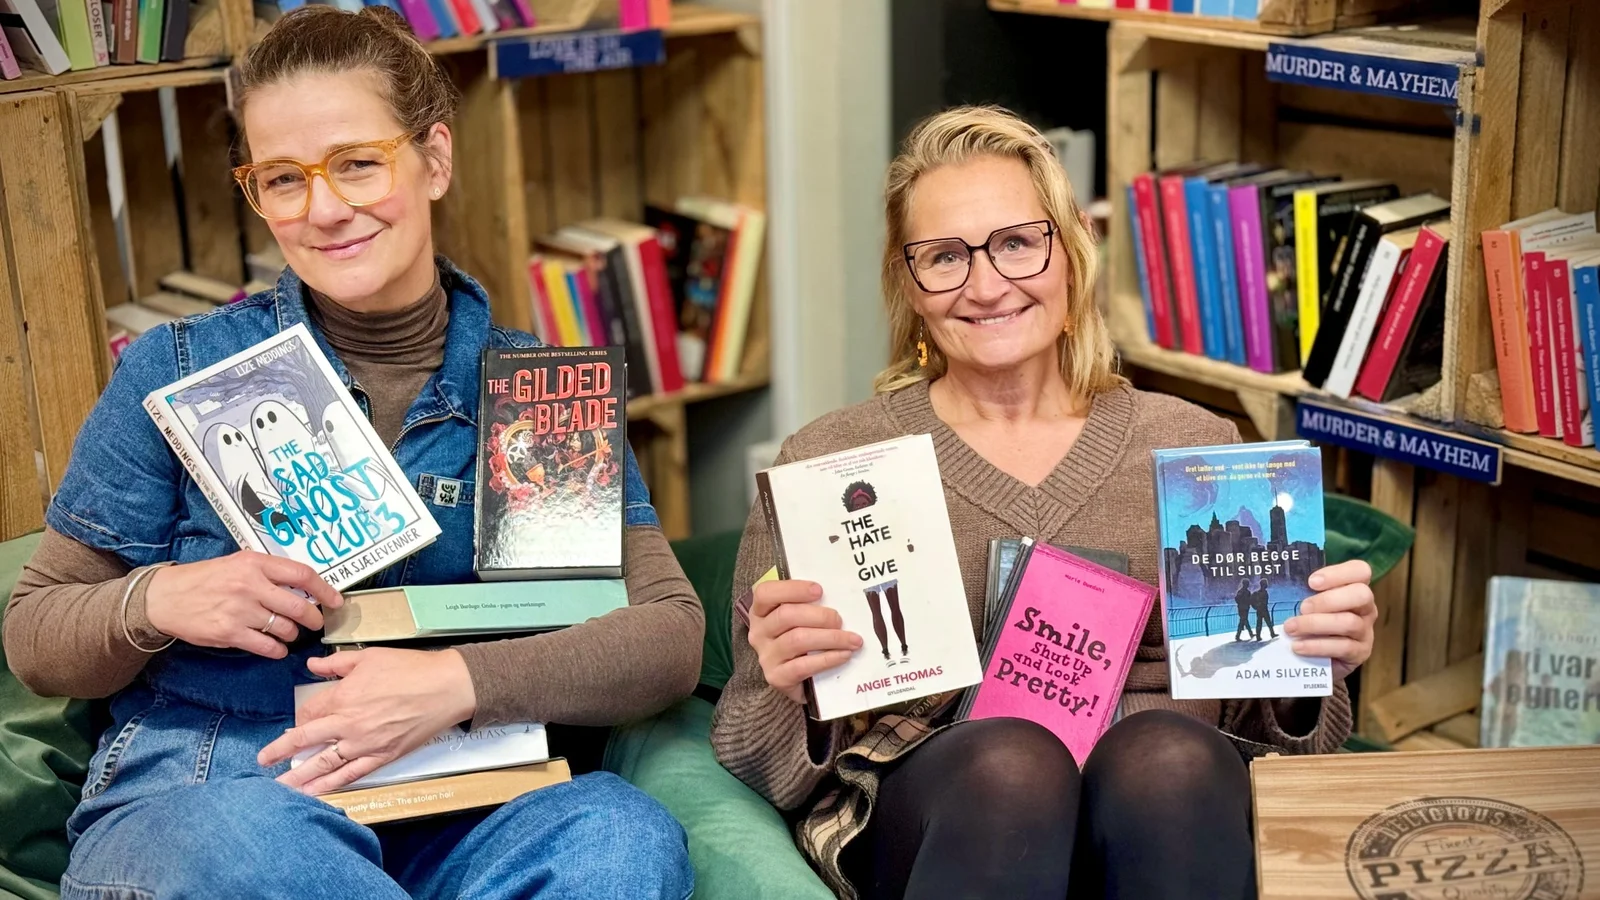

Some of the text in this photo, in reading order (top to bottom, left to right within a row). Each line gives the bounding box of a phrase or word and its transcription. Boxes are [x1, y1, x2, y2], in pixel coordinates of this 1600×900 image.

[91, 0, 102, 37] LOSER
[1266, 52, 1459, 100] MURDER & MAYHEM
[234, 340, 297, 377] LIZE MEDDINGS
[487, 362, 611, 403] THE GILDED
[534, 397, 617, 436] BLADE
[268, 439, 303, 463] THE
[1302, 409, 1491, 473] MURDER & MAYHEM
[145, 398, 166, 422] LIZE
[162, 424, 200, 472] MEDDINGS
[207, 490, 226, 512] SAD
[220, 510, 249, 545] GHOST
[273, 451, 329, 497] SAD
[261, 456, 381, 546] GHOST
[763, 490, 772, 514] Angie
[306, 502, 406, 565] CLUB 3
[841, 514, 874, 534] THE
[849, 526, 892, 550] HATE
[339, 562, 353, 583] PÅ
[351, 527, 421, 574] SJÆLEVENNER
[853, 551, 865, 565] U
[1191, 550, 1300, 564] DE DØR BEGGE
[858, 559, 898, 582] GIVE
[1210, 564, 1281, 577] TIL SIDST
[1014, 607, 1112, 671] Smile,
[1013, 652, 1081, 686] and Look
[1030, 642, 1071, 667] Shut
[1549, 653, 1598, 680] var
[855, 665, 943, 694] ANGIE THOMAS
[1235, 667, 1327, 680] ADAM SILVERA
[887, 686, 915, 696] GYLDENDAL
[470, 728, 507, 740] GLASS
[346, 804, 368, 814] Holly
[369, 800, 395, 810] Black:
[396, 798, 412, 806] The
[413, 793, 438, 803] stolen
[1379, 805, 1506, 839] DELICIOUS
[1422, 836, 1485, 854] Finest
[1363, 840, 1567, 888] PIZZA
